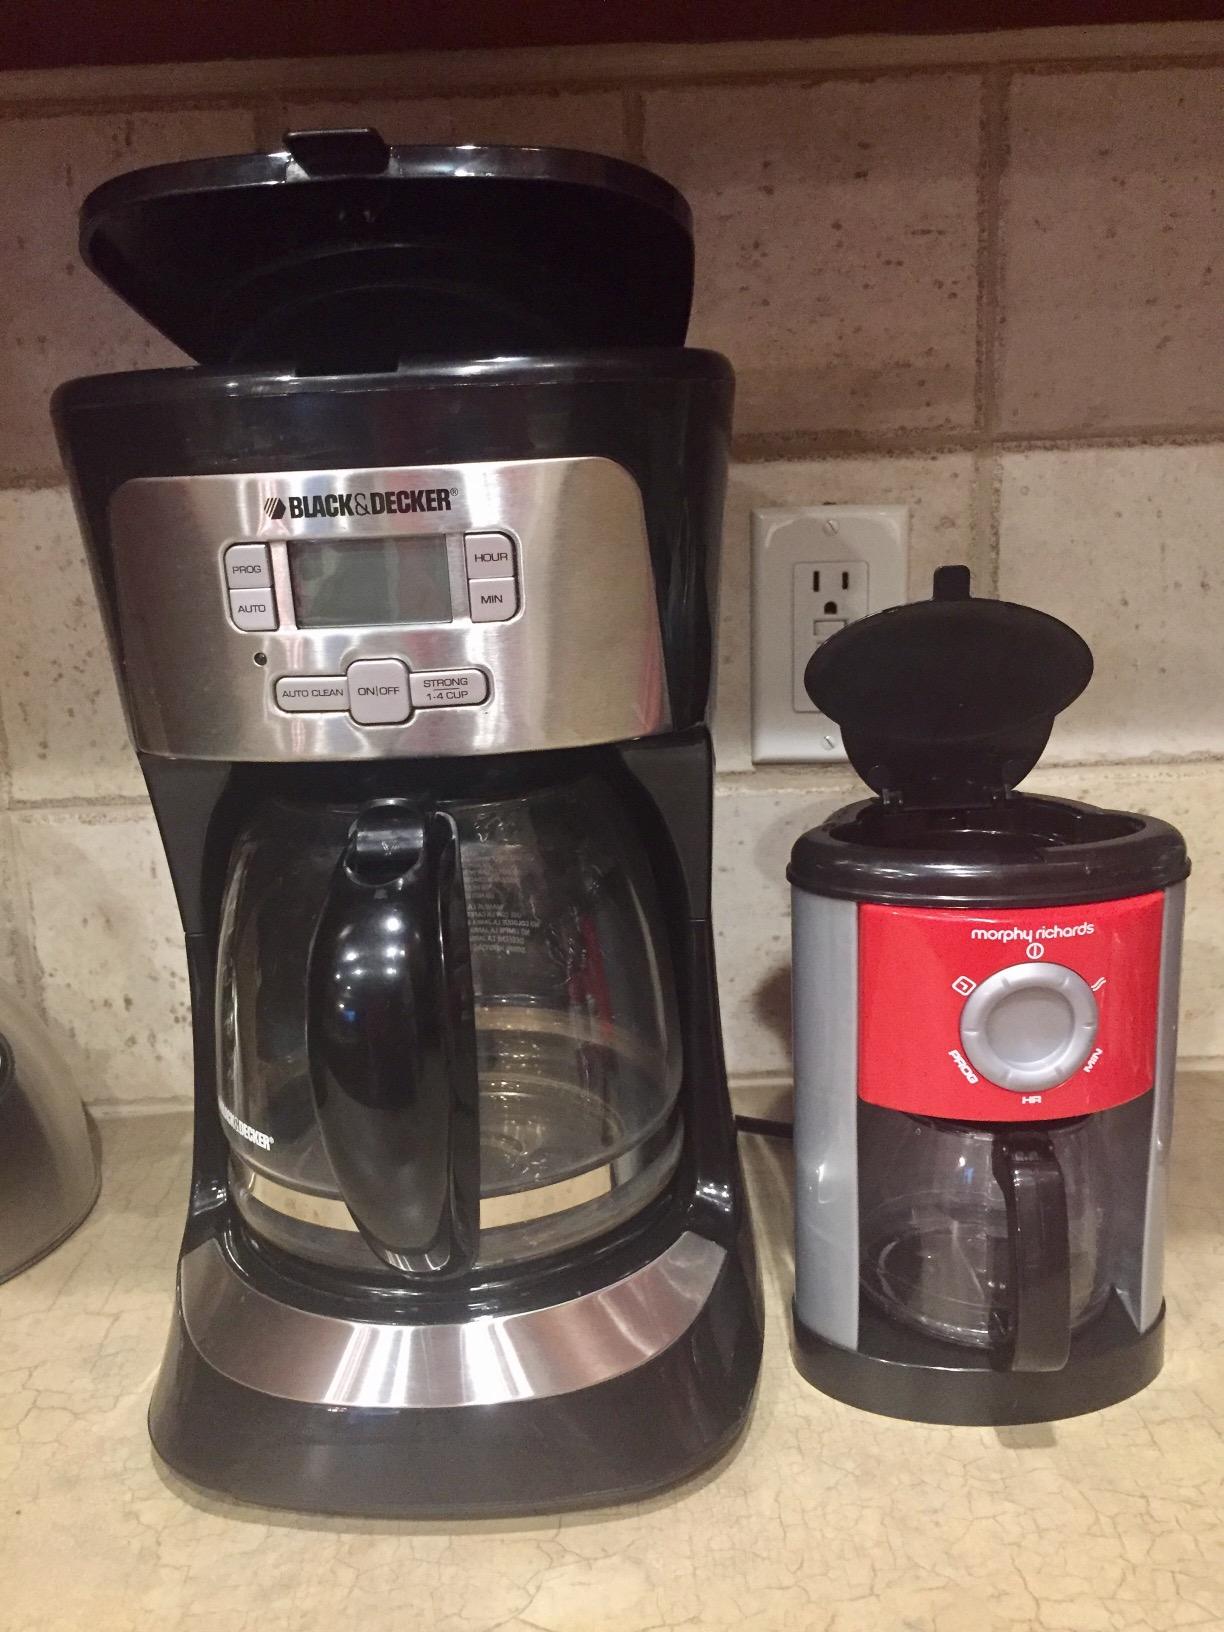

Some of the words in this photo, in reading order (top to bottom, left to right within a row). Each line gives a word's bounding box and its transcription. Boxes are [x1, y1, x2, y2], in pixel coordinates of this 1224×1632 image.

[474, 552, 508, 562] HOUR
[232, 565, 262, 574] PROG
[480, 594, 503, 604] MIN
[238, 604, 266, 613] AUTO
[423, 677, 468, 688] STRONG
[282, 689, 309, 698] AUTO
[311, 688, 344, 697] CLEAN
[426, 692, 444, 701] 1-4
[446, 690, 469, 699] CUP
[971, 926, 1033, 943] morphy
[1036, 922, 1095, 939] richards
[1083, 1048, 1103, 1073] MIN
[948, 1049, 979, 1084] PROG
[1022, 1095, 1042, 1104] HR
